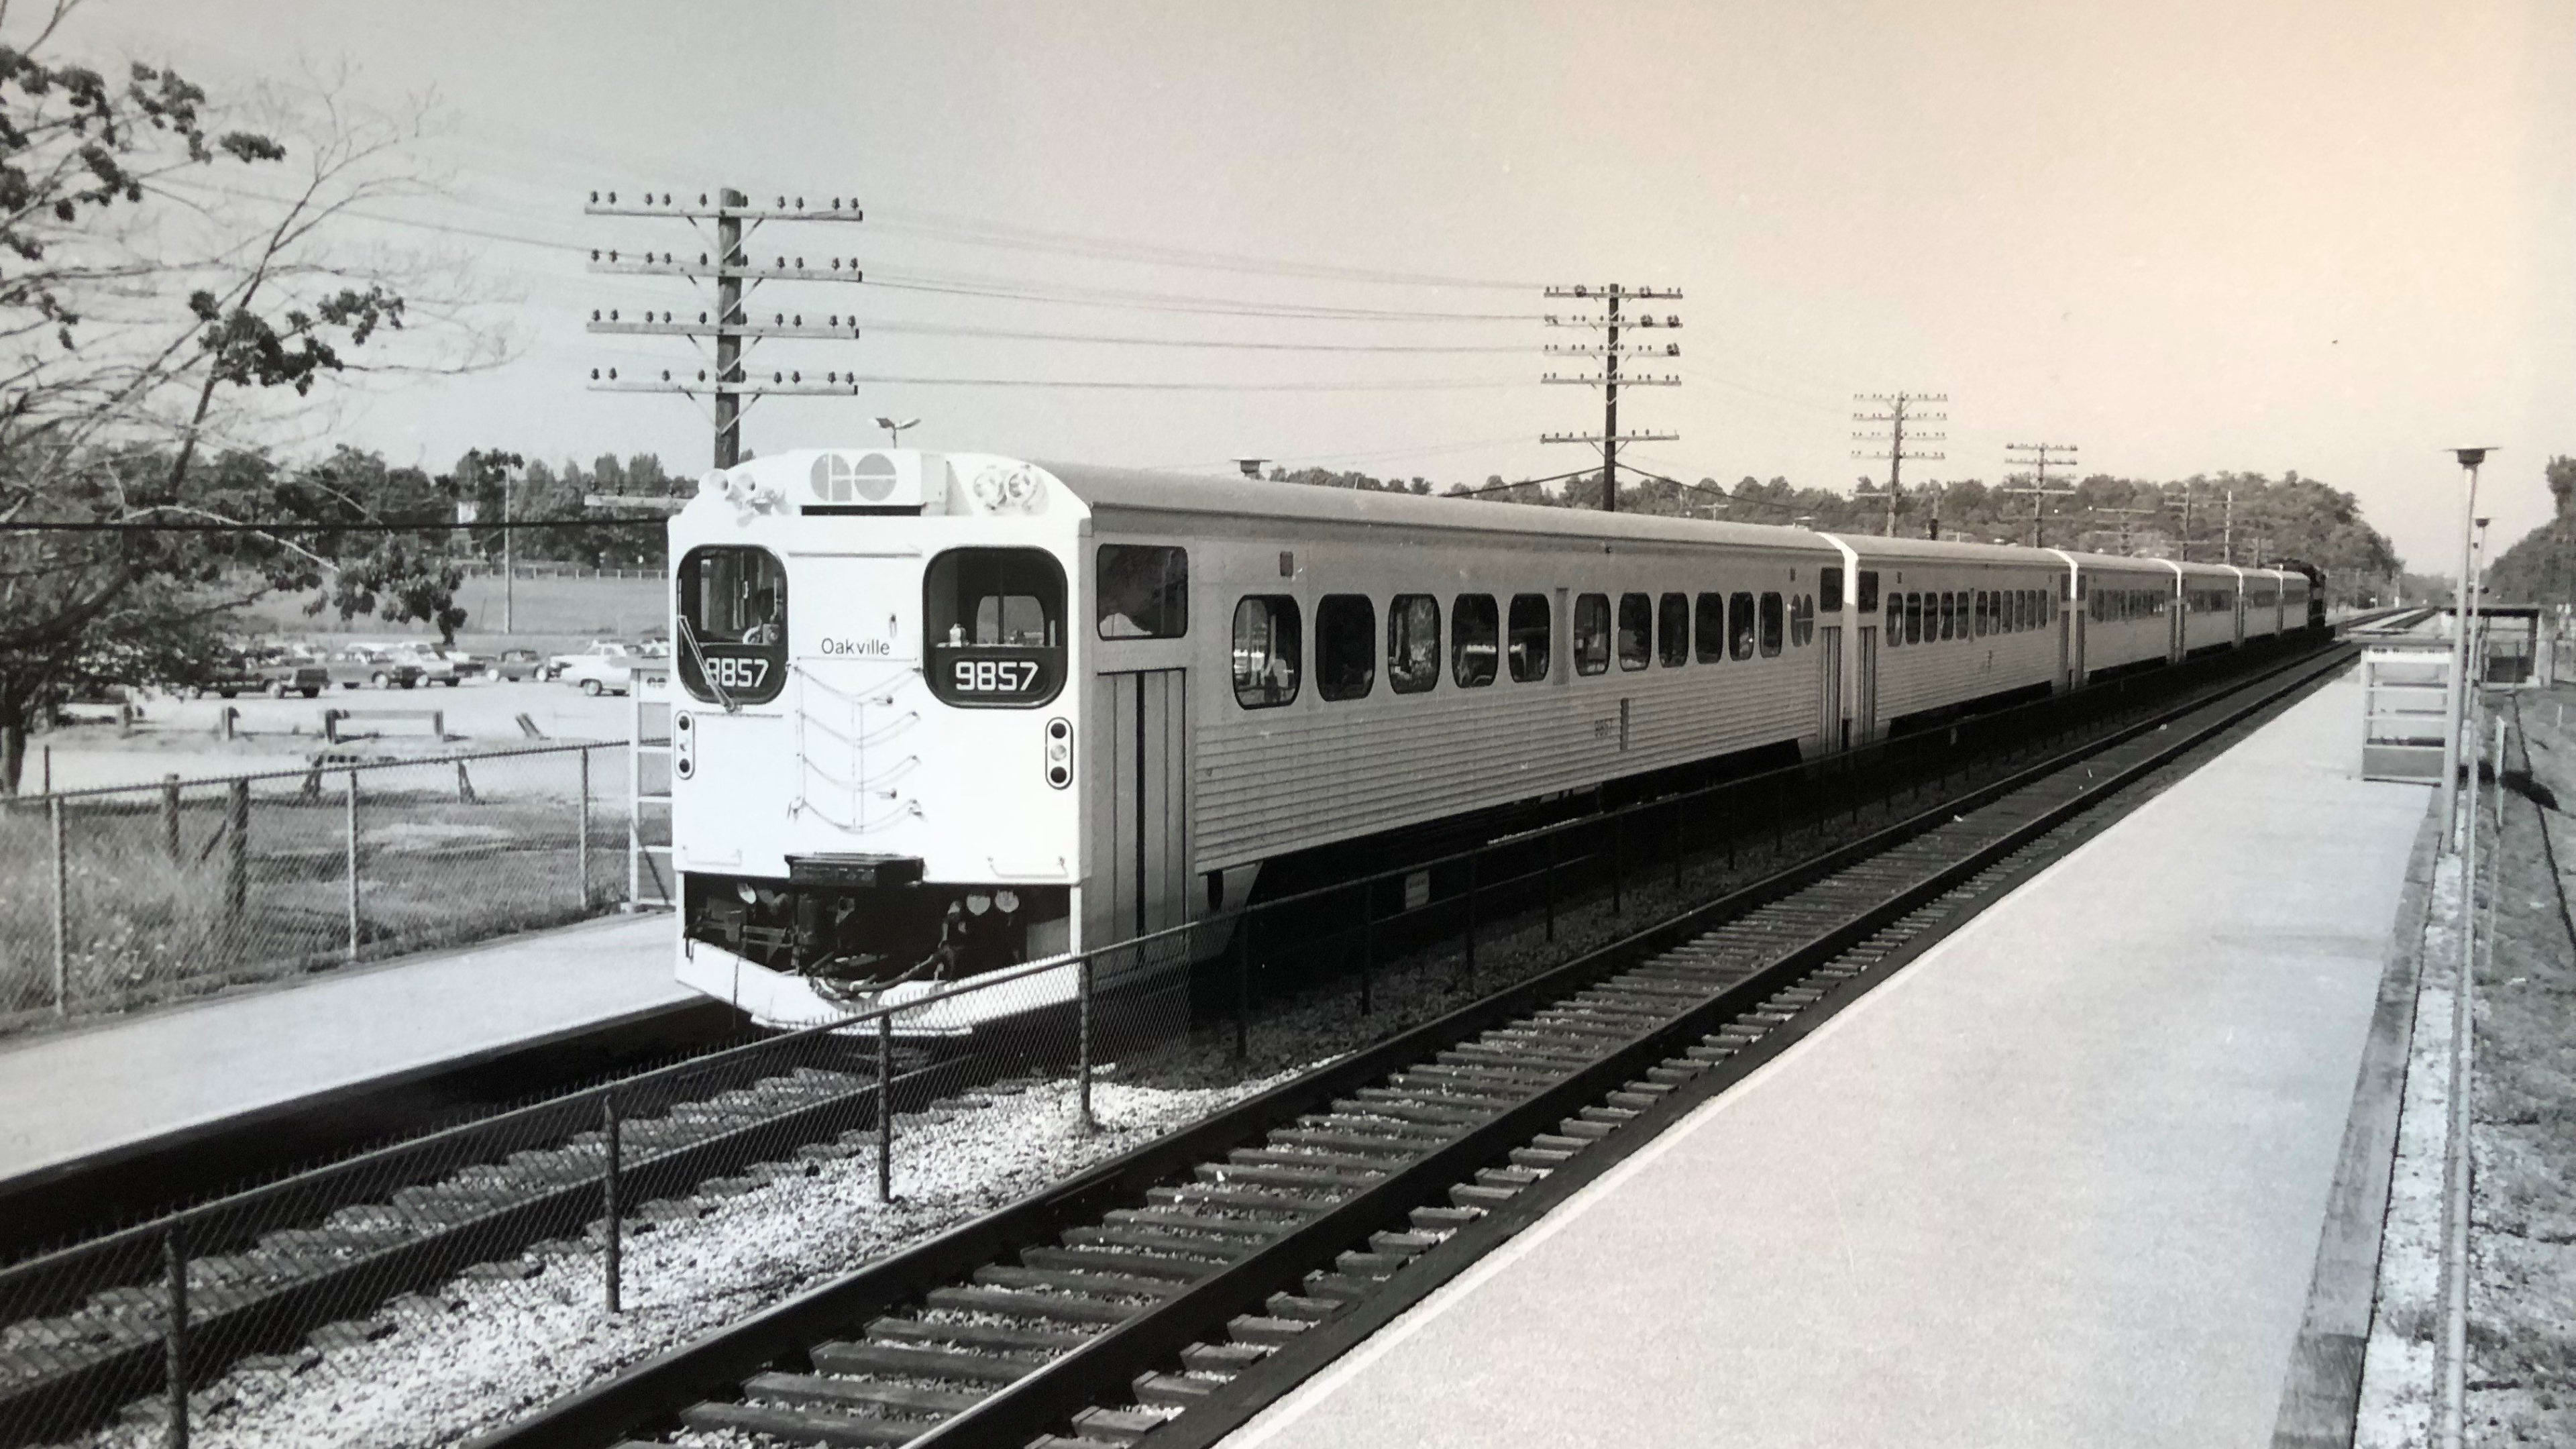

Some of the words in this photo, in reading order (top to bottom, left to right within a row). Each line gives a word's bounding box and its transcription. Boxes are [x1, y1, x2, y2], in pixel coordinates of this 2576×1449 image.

[822, 638, 890, 655] Oakville
[706, 657, 769, 687] 9857
[956, 661, 1039, 691] 9857
